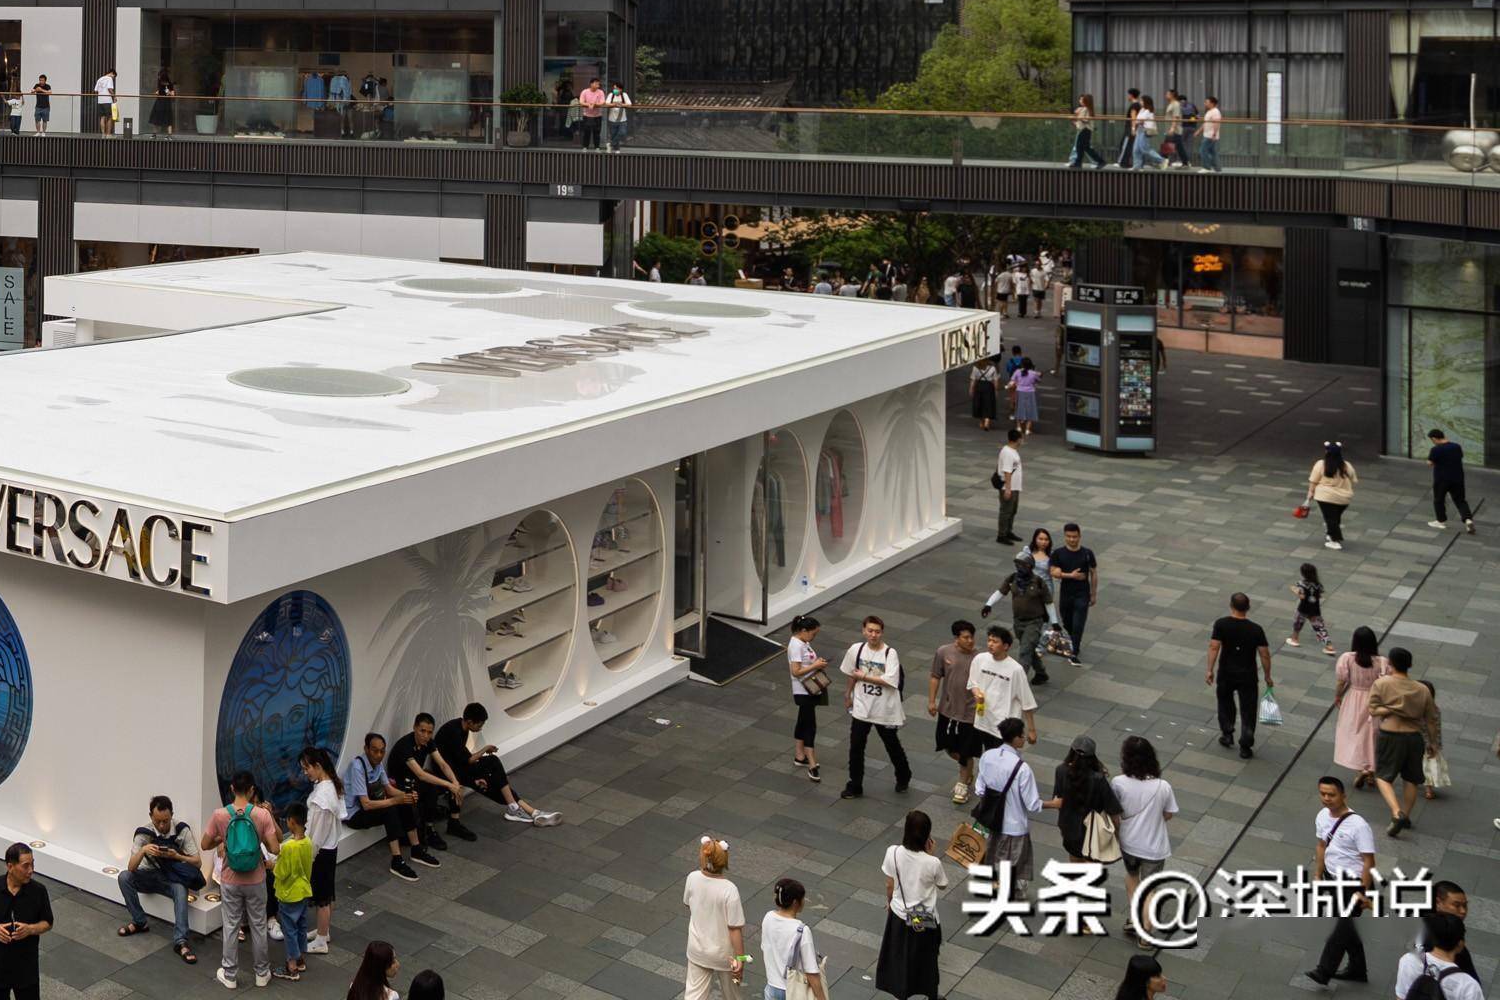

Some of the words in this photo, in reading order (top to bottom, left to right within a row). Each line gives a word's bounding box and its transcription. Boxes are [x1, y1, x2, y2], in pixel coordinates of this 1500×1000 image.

[4, 274, 15, 336] SALE
[941, 320, 991, 371] VERSACE
[863, 683, 883, 697] 123
